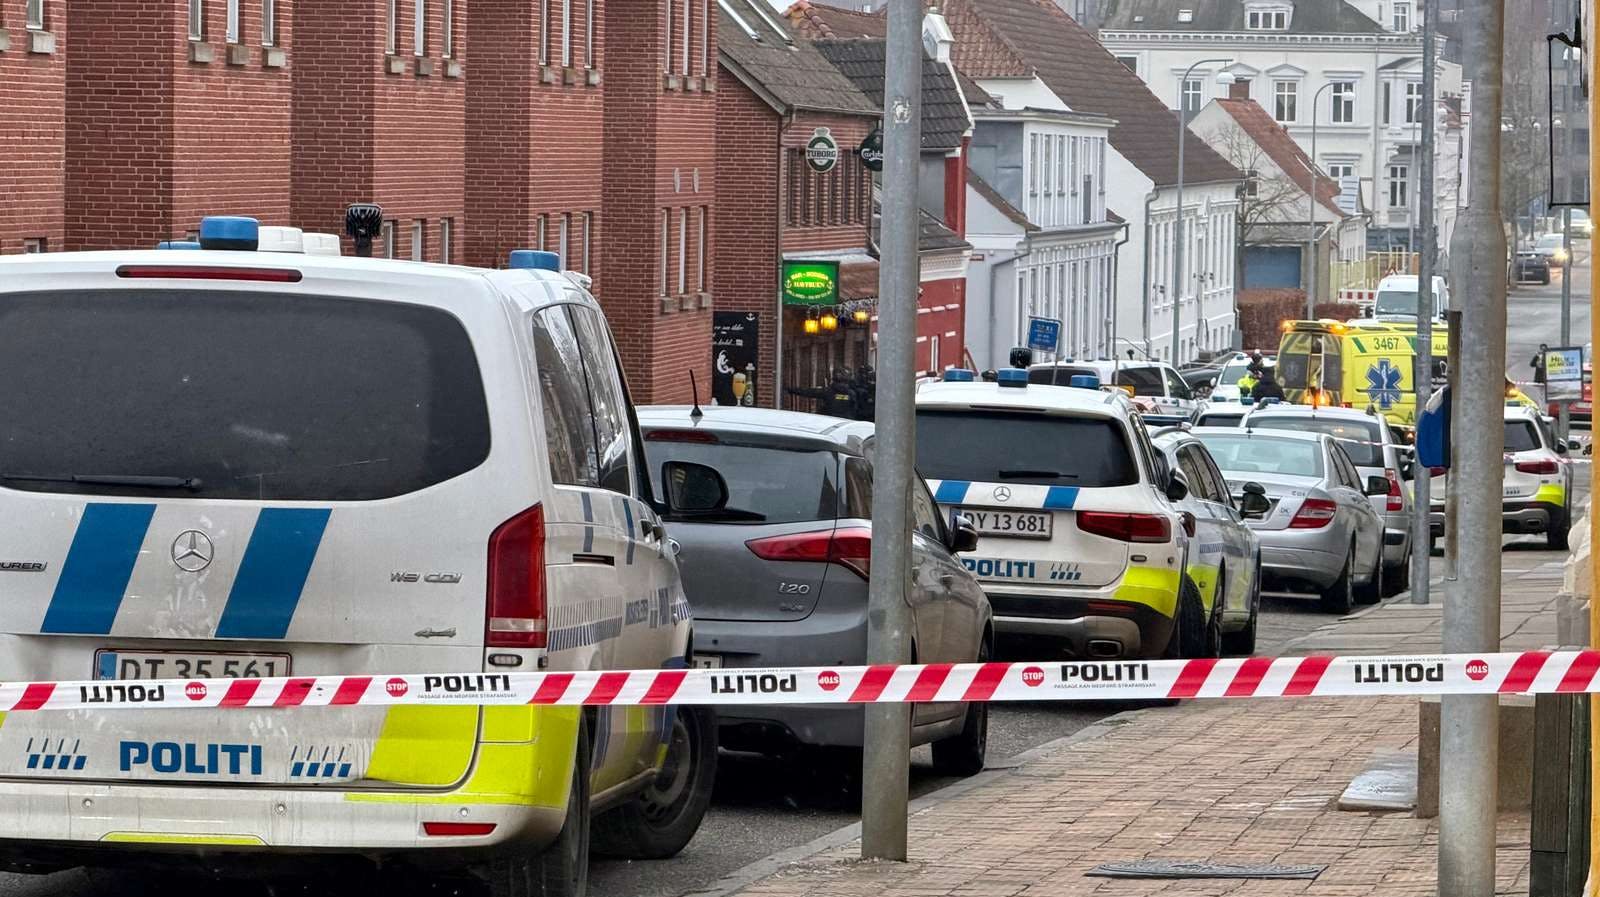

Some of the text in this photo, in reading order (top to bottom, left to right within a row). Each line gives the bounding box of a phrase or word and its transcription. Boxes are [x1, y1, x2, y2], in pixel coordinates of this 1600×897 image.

[808, 150, 837, 158] TUBORG
[861, 148, 883, 161] Carlsb
[1373, 337, 1399, 351] 3467
[993, 514, 1011, 530] 13
[1015, 515, 1046, 531] 681
[0, 562, 42, 570] URER
[961, 559, 1035, 579] POLITI
[779, 582, 810, 594] i20
[120, 659, 275, 680] DT 35 561
[1023, 664, 1149, 681] STOP POLITI
[1354, 663, 1488, 683] POLITI STOP
[386, 675, 511, 692] STOP POLITI
[710, 674, 840, 693] POLITI STOP
[80, 685, 207, 703] POLITI STOP
[119, 741, 263, 775] POLITI
